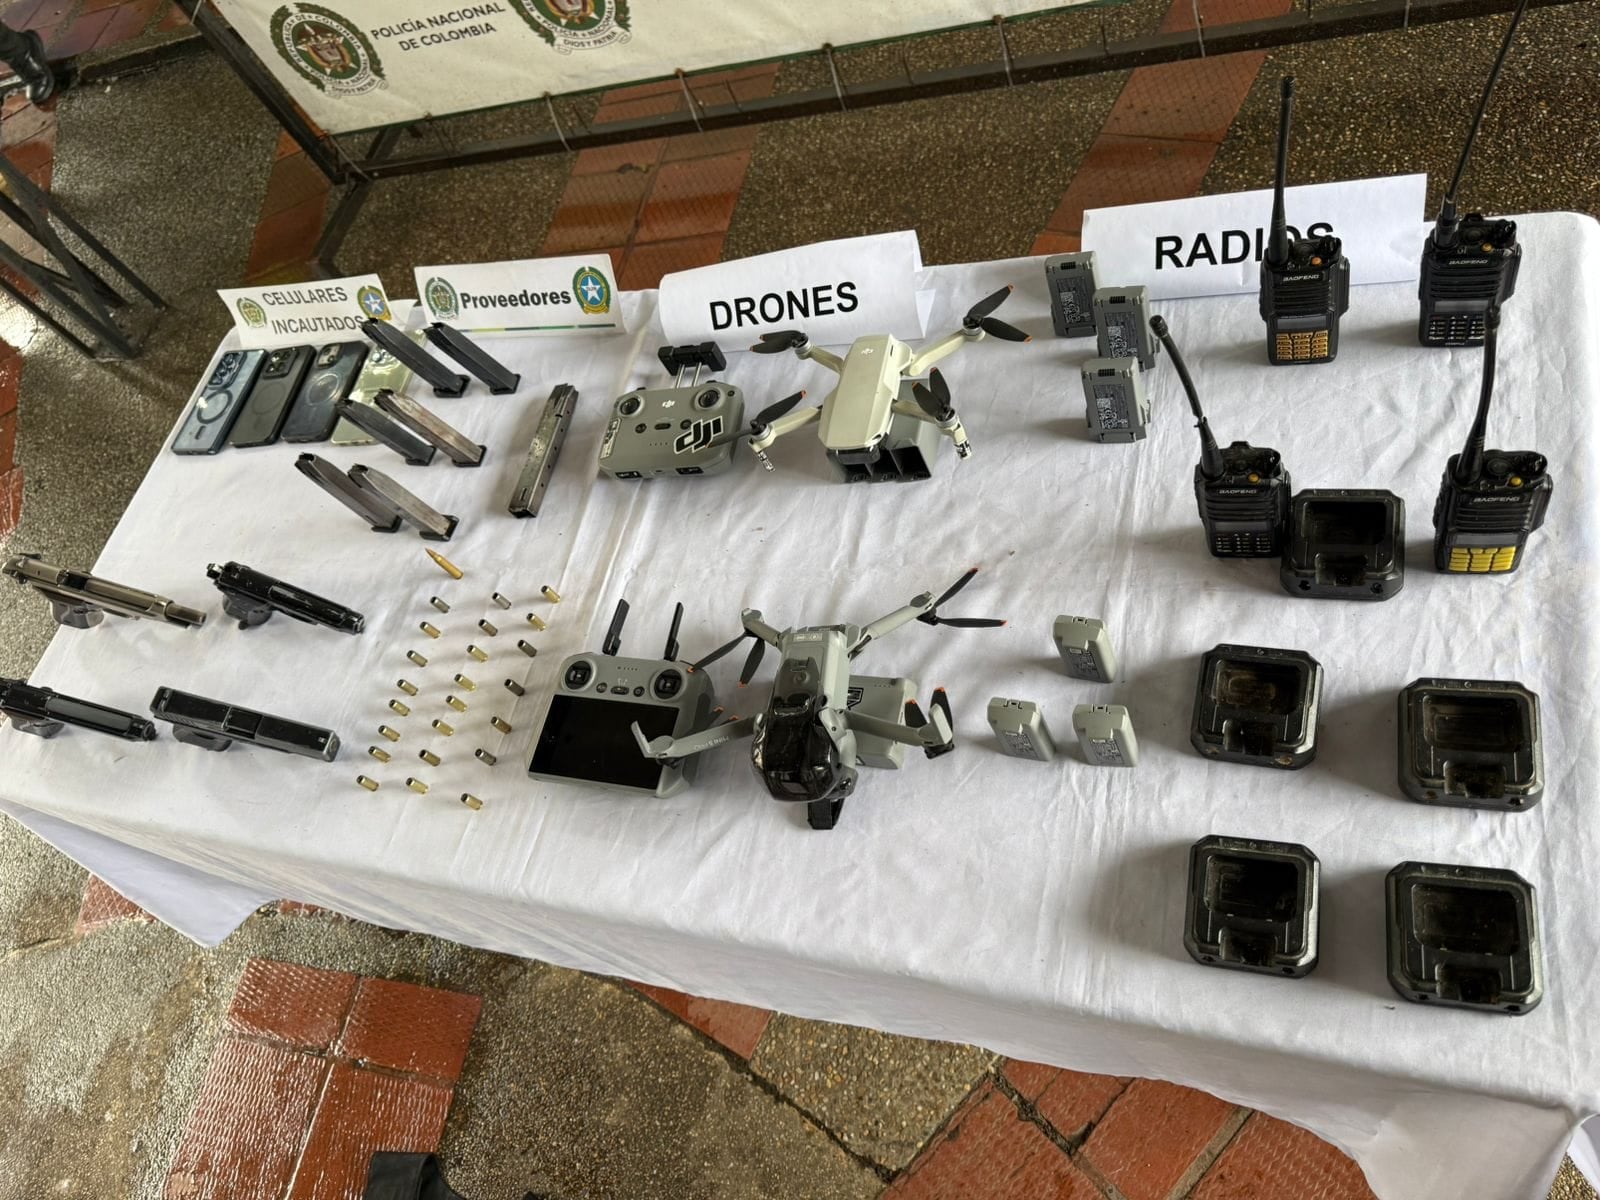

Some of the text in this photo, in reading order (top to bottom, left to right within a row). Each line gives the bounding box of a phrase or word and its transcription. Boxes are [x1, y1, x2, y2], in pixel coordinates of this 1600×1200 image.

[370, 18, 428, 40] POLICÍA
[426, 2, 506, 28] NACIONAL
[398, 22, 497, 51] DE COLOMBIA
[1155, 222, 1334, 269] RADI
[1282, 274, 1321, 282] BAOFENG
[262, 286, 349, 306] CELULARES
[459, 289, 572, 309] Proveedores
[710, 281, 859, 330] DRONES
[271, 315, 365, 335] INCAUTADOS
